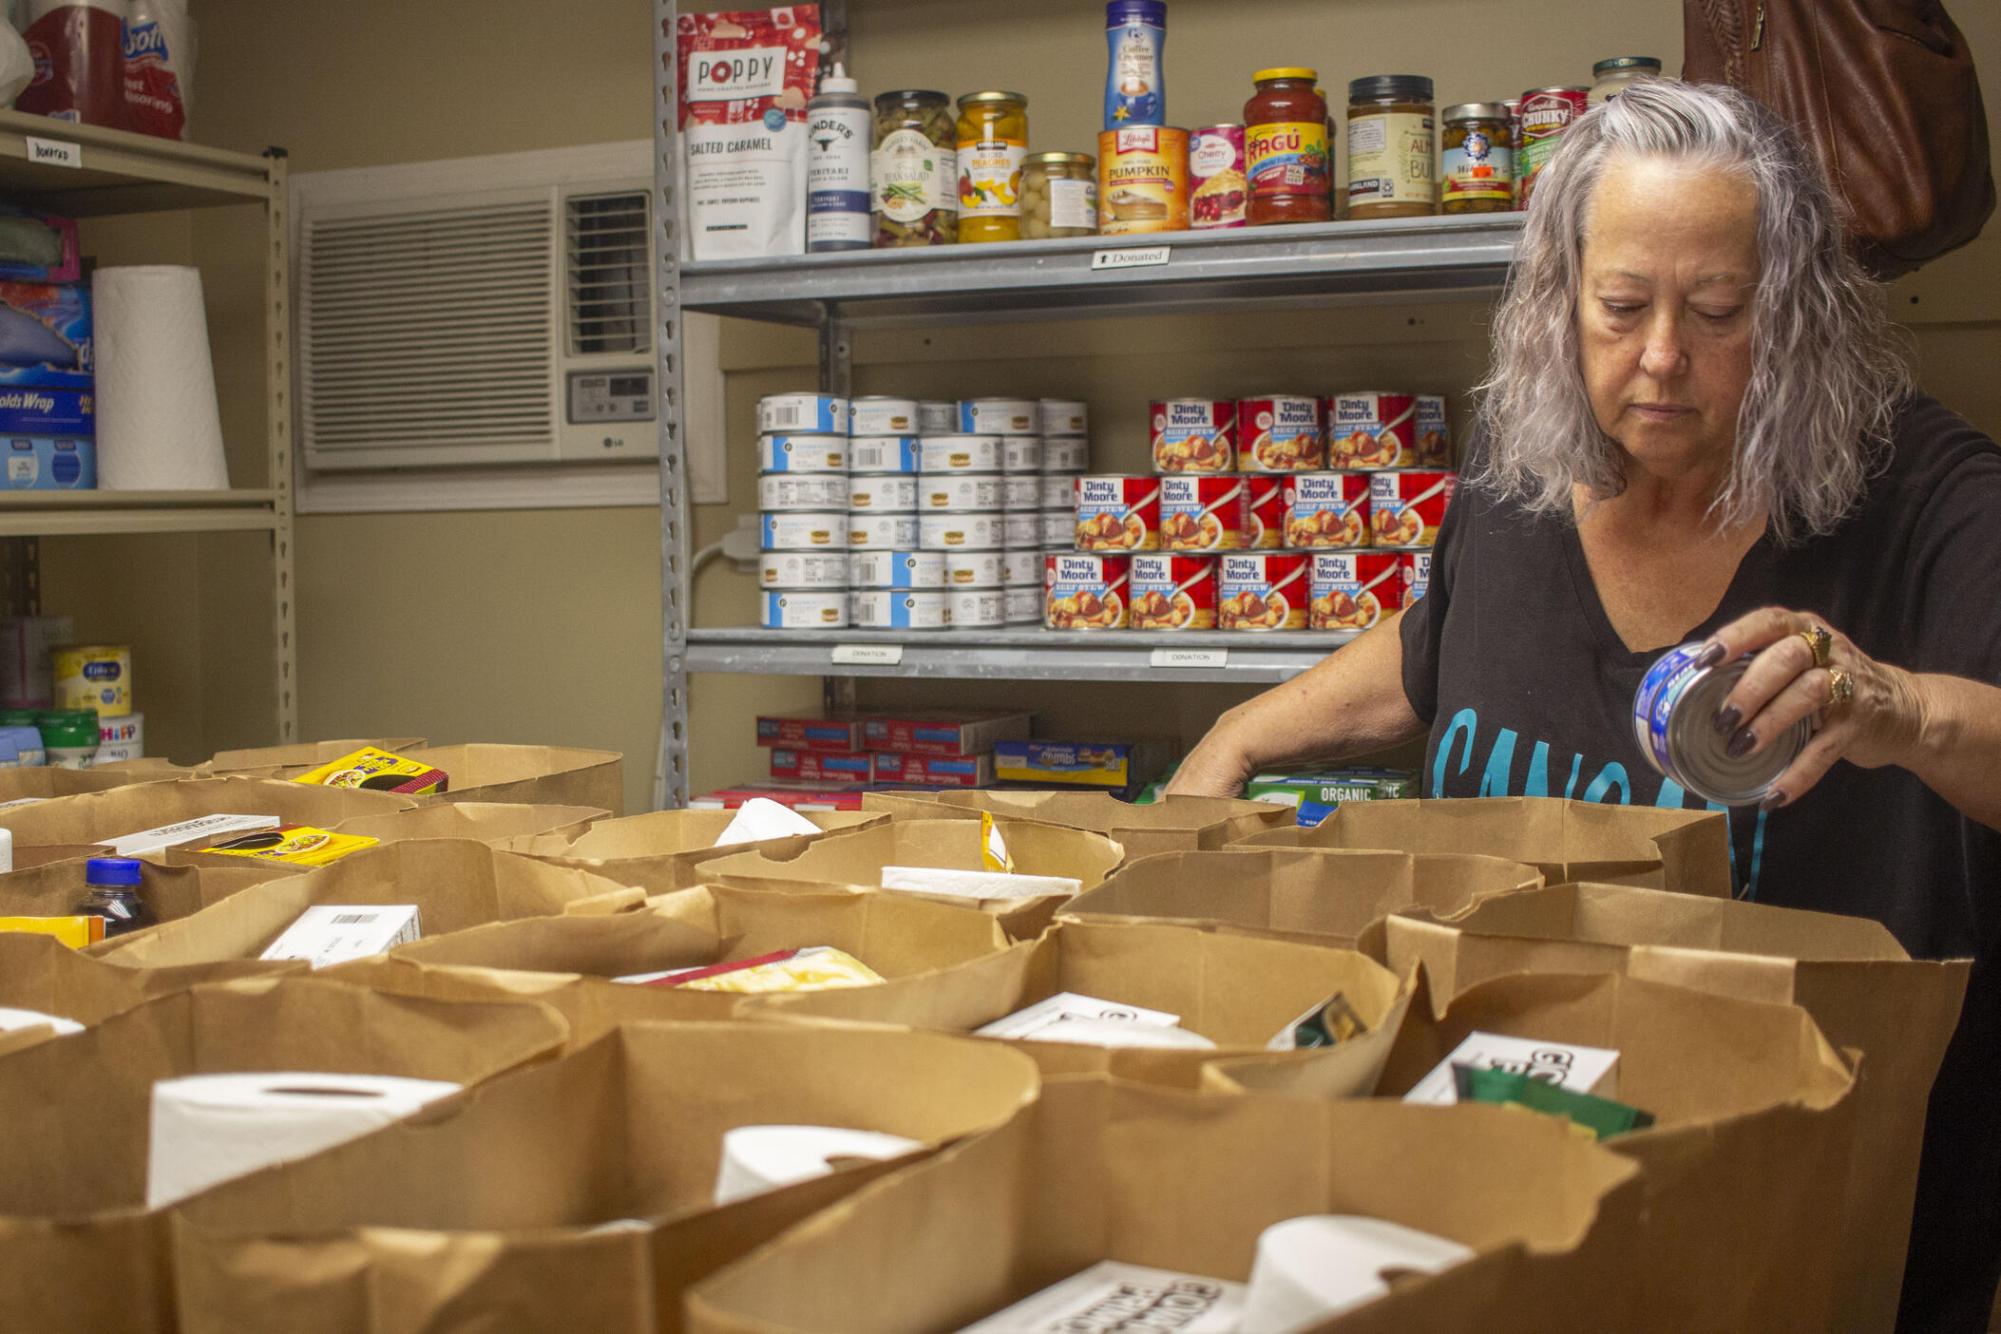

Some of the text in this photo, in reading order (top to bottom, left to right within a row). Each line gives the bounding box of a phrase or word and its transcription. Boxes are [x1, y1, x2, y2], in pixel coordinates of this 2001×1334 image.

[697, 56, 773, 84] POPPY
[1522, 109, 1569, 128] CHUNKY
[690, 138, 773, 156] SALTED CARAMEL
[1199, 150, 1226, 160] Cherry
[1109, 167, 1170, 179] PUMPKIN
[1112, 251, 1163, 263] Donated
[23, 392, 55, 413] Wrap
[1282, 402, 1312, 414] Dinty
[1340, 400, 1369, 412] Dinty
[1173, 404, 1206, 416] Dinty
[1338, 410, 1373, 421] Moore
[1171, 413, 1209, 424] Moore
[1279, 412, 1314, 423] Moore
[1085, 481, 1115, 492] Dinty
[1165, 480, 1190, 492] Dinty
[1302, 478, 1334, 490] Dinty
[1084, 491, 1118, 501] Moore
[1163, 491, 1193, 501] Moore
[1300, 489, 1338, 499] Moore
[1062, 559, 1094, 571] Dinty
[1135, 558, 1162, 570] Dinty
[1227, 558, 1256, 571] Dinty
[1317, 558, 1347, 570] Dinty
[1060, 570, 1097, 580] Moore
[1135, 570, 1166, 580] Moore
[1226, 570, 1260, 580] Moore
[1316, 569, 1350, 579] Moore
[1320, 787, 1372, 801] ORGANIC
